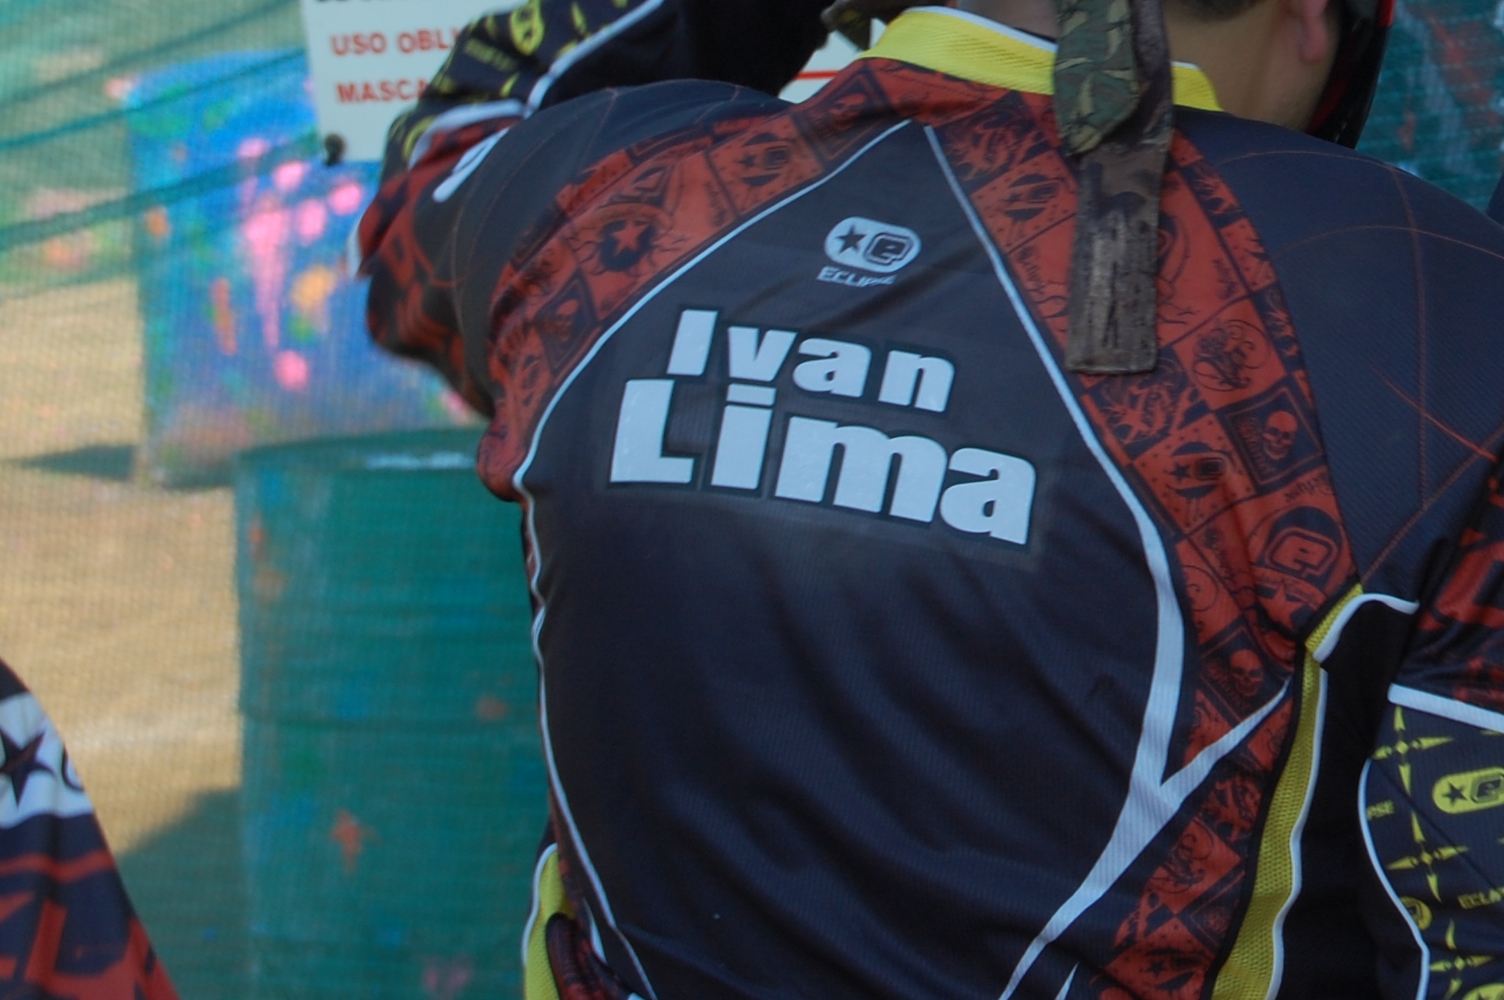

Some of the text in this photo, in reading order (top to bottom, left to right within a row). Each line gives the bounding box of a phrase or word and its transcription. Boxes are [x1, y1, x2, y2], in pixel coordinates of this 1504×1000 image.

[331, 32, 386, 56] USO
[666, 309, 955, 412] Ivan
[610, 378, 1037, 545] Lima
